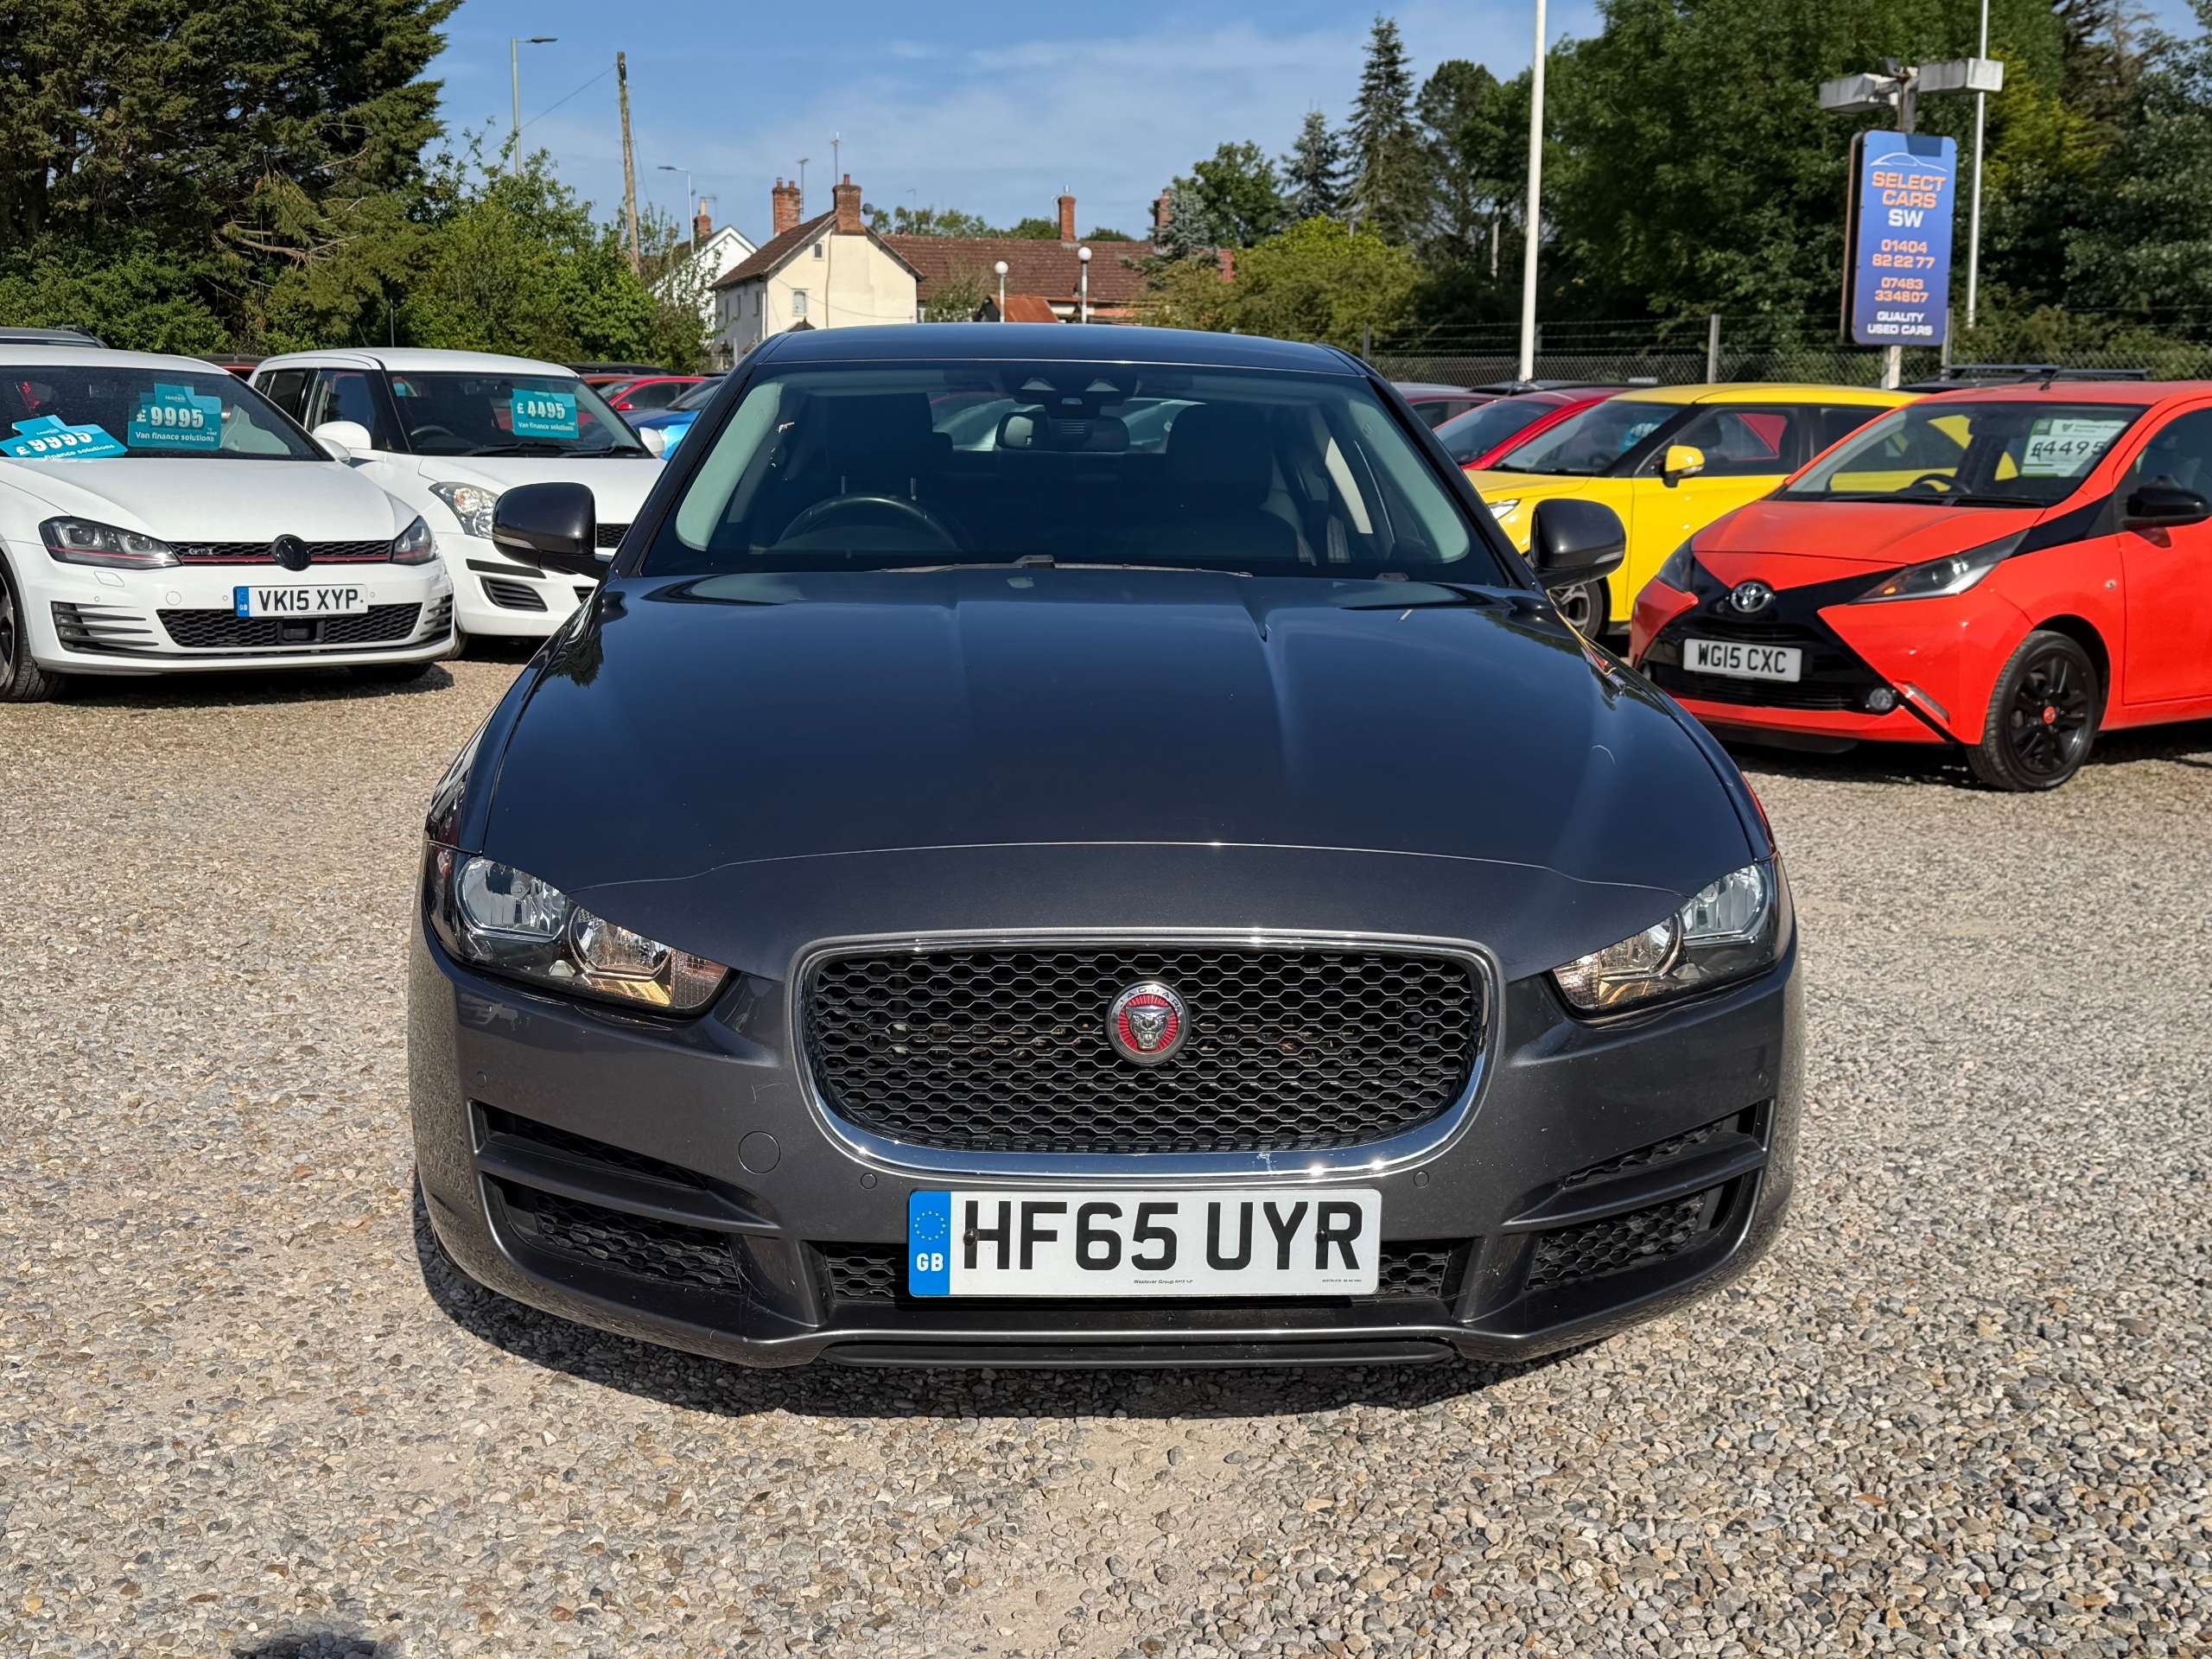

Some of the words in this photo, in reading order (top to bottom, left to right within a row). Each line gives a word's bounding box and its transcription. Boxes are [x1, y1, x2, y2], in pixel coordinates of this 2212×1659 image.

[1872, 171, 1946, 192] SELECT
[1882, 189, 1936, 209] CARS
[1888, 208, 1923, 228] SW
[1881, 238, 1928, 253] 01404
[1881, 276, 1923, 290] 07483
[1874, 289, 1929, 303] 334807
[1877, 311, 1924, 322] QUALITY
[1866, 322, 1899, 334] USED
[1901, 324, 1933, 335] CARS
[259, 590, 309, 612] VK15
[316, 588, 359, 610] XYP
[1698, 643, 1741, 669] WG15
[1747, 648, 1787, 674] CXC
[916, 1252, 944, 1273] GB
[963, 1199, 1179, 1271] HF65
[1206, 1201, 1363, 1271] UYR
